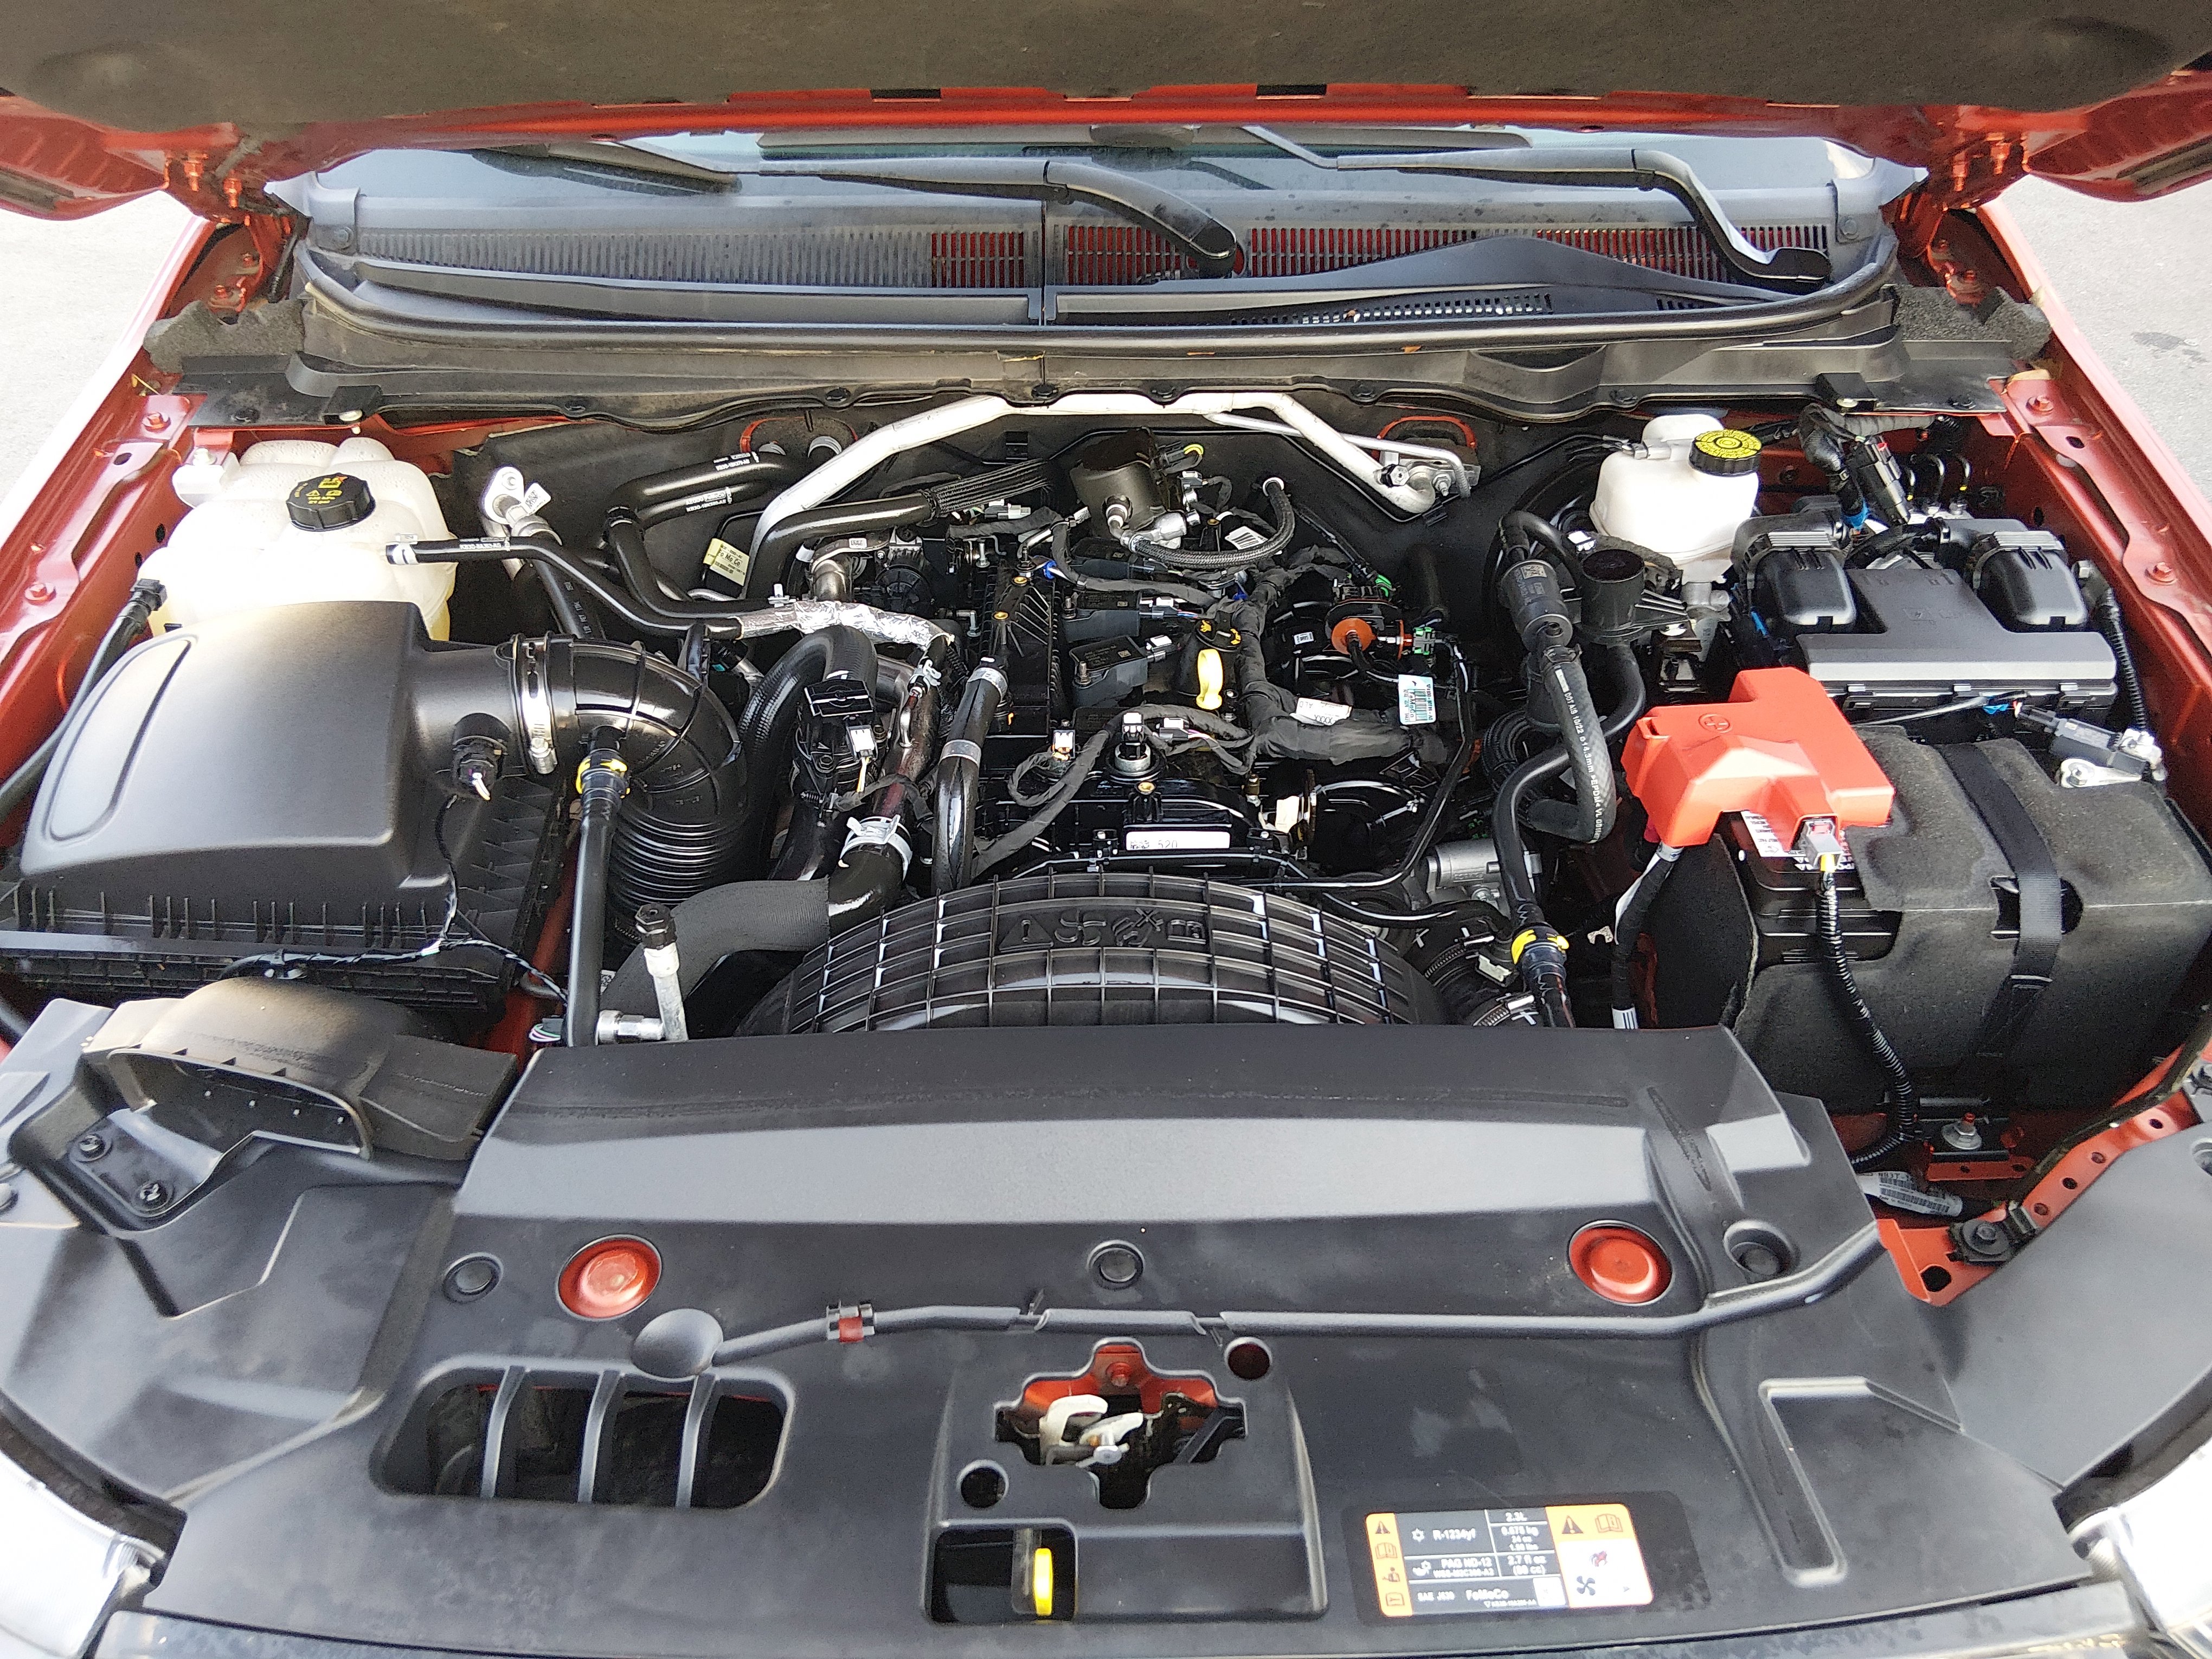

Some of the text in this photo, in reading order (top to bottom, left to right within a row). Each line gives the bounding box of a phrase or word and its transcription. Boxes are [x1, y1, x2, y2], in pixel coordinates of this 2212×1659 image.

[1572, 716, 1585, 735] 10/22
[1505, 1511, 1527, 1522] 2.3L
[1432, 1528, 1477, 1541] R-1234yf
[1526, 1526, 1540, 1537] kg
[1507, 1554, 1522, 1566] 2.7
[1465, 1587, 1510, 1600] FoMoCo
